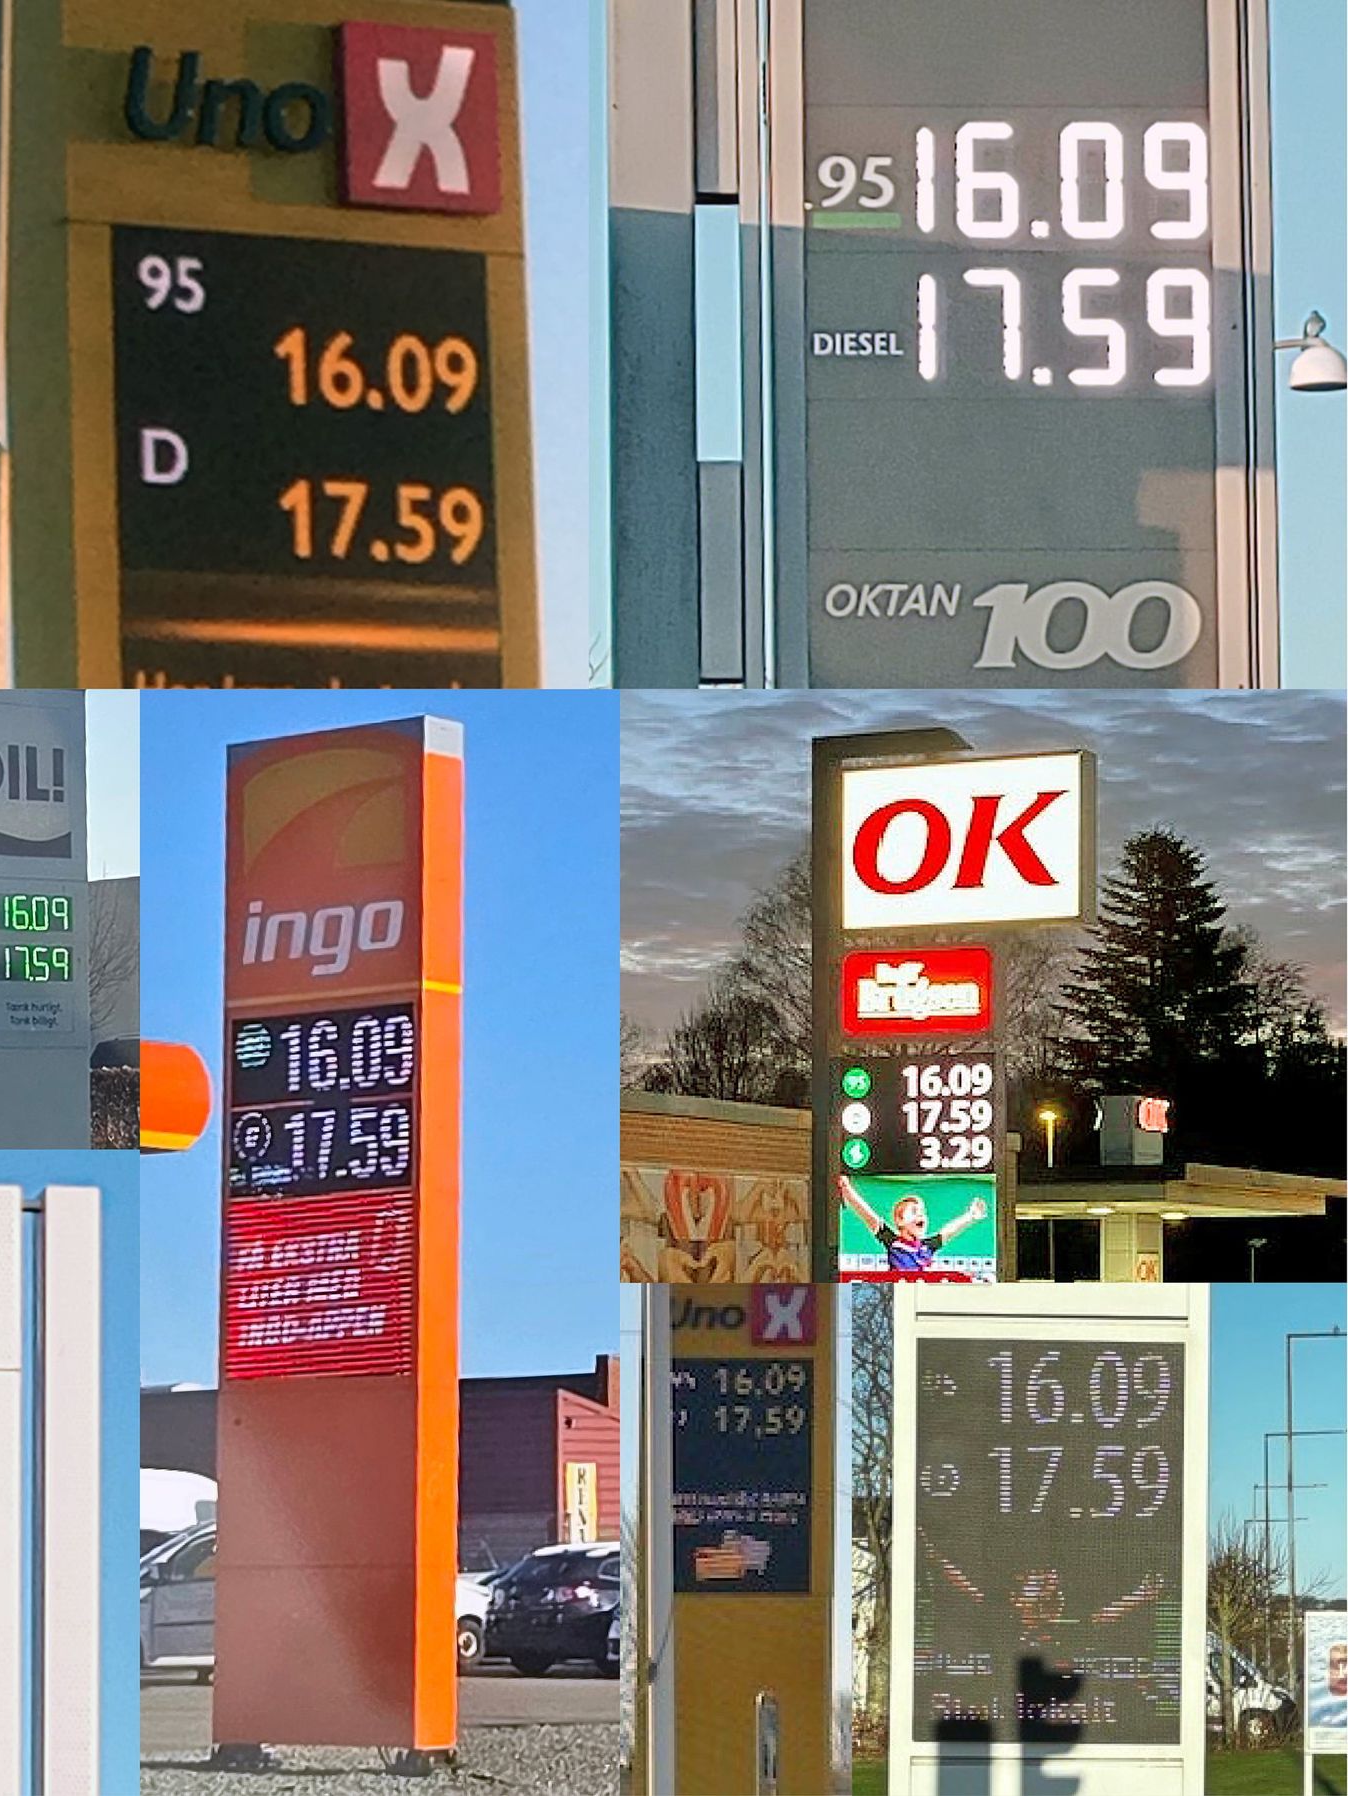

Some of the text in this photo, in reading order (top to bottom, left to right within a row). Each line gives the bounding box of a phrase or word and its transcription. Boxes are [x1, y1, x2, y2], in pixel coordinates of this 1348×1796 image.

[125, 46, 475, 195] Uno X
[916, 120, 1209, 240] 16.09
[137, 255, 206, 314] 95
[813, 332, 904, 356] DIESEL
[917, 267, 1211, 387] 17.59
[272, 326, 479, 415] 16.09
[140, 428, 188, 485] D
[278, 478, 485, 565] 17.59
[824, 580, 1202, 671] OKTAN 100
[852, 790, 1070, 894] OK
[4, 895, 69, 931] 16.09
[242, 899, 405, 976] ingo
[5, 945, 69, 981] 17.59
[280, 1014, 414, 1092] 16.09
[902, 1062, 993, 1098] 16.09
[284, 1103, 410, 1180] 17.59
[902, 1099, 993, 1134] 17.59
[919, 1134, 993, 1169] 3.29
[764, 1286, 809, 1340] X
[713, 1362, 807, 1396] 16.09
[987, 1351, 1170, 1428] 16.09
[987, 1445, 1170, 1519] 17.59
